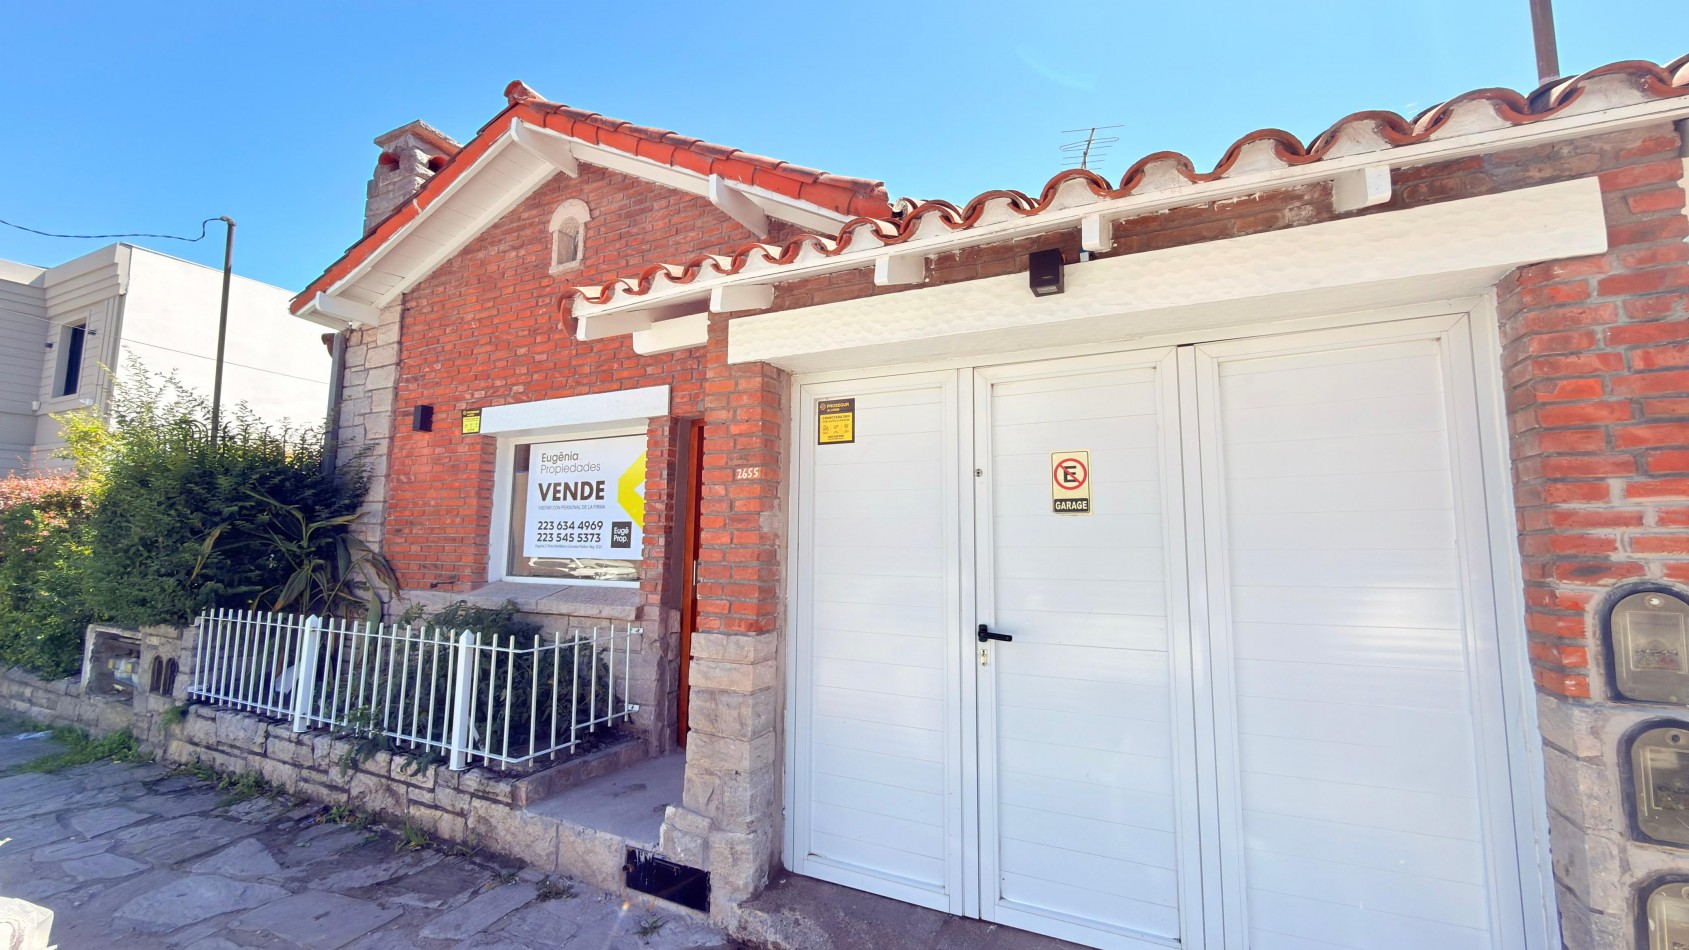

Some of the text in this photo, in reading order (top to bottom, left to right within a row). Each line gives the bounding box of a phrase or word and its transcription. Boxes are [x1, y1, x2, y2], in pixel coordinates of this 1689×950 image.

[541, 451, 579, 464] Eugênia
[541, 462, 601, 475] Propiedades
[736, 467, 759, 479] 2655
[538, 480, 605, 501] VENDE
[1055, 501, 1088, 510] GARAGE
[537, 520, 603, 530] 223 634 4969
[613, 526, 629, 535] Eugê
[537, 533, 602, 543] 223 545 5373
[613, 534, 629, 543] Prop.
